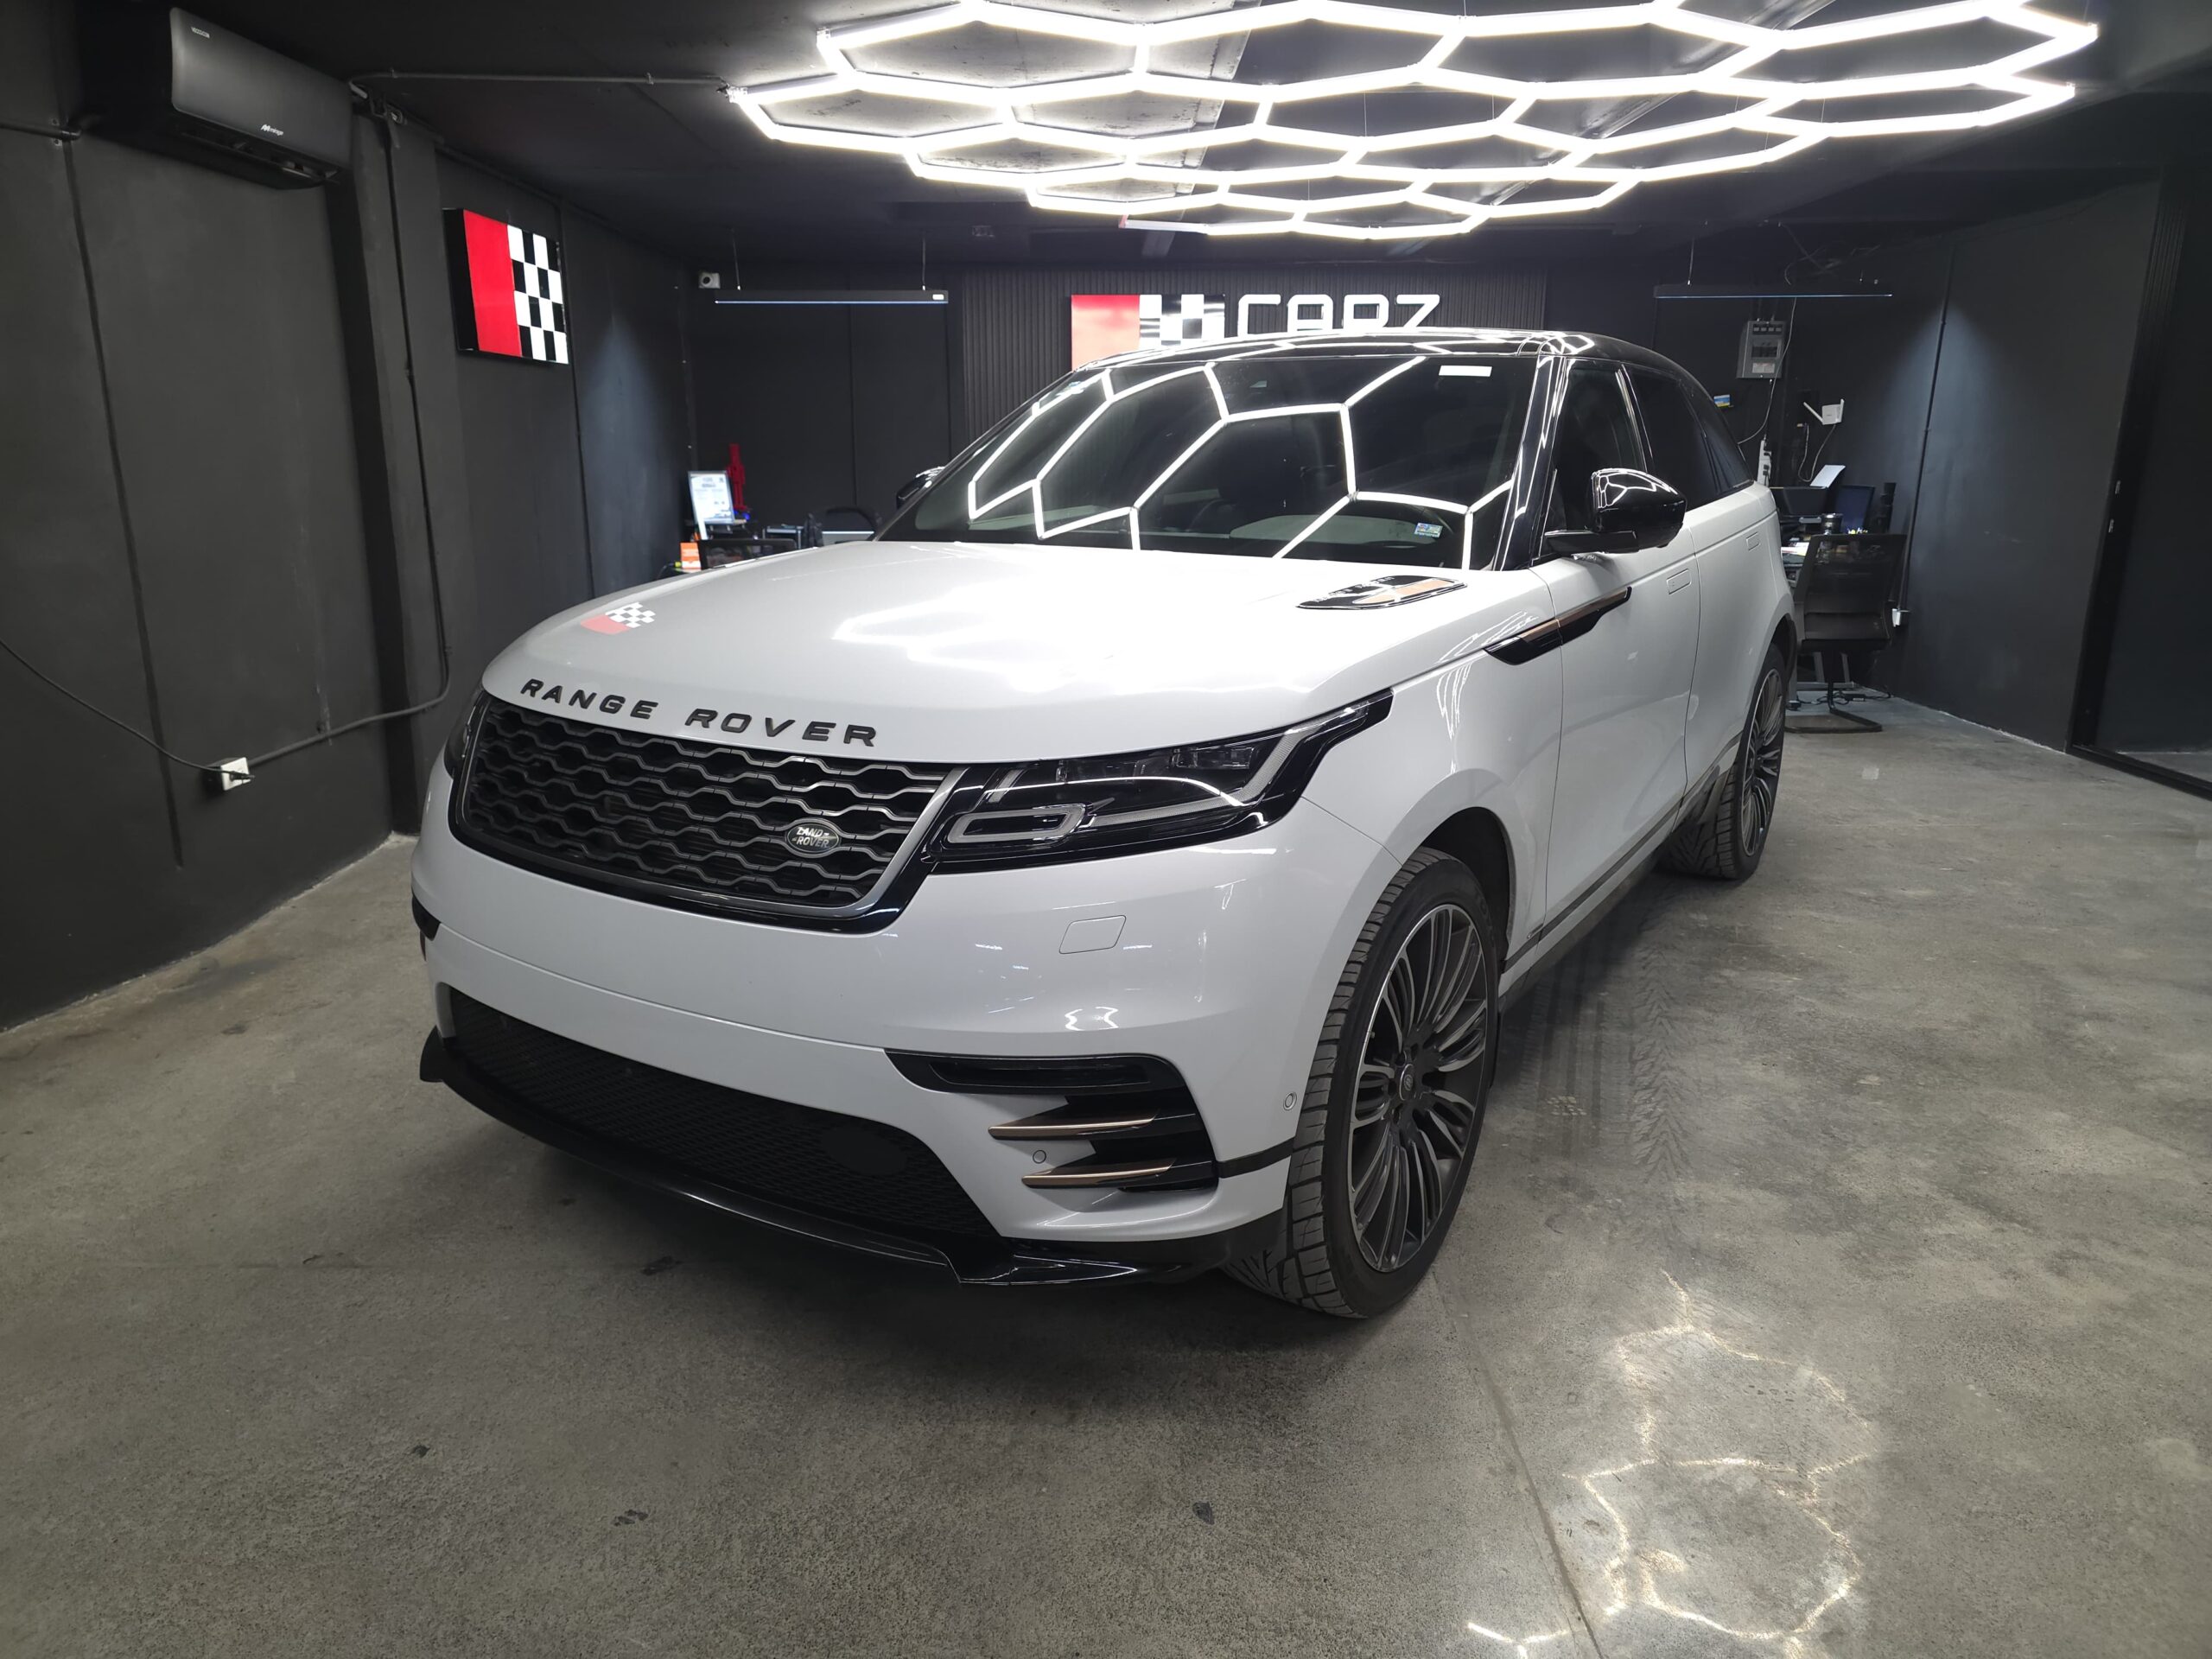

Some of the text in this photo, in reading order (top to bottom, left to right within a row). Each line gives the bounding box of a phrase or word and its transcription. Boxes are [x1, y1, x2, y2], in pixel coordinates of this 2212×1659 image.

[520, 678, 876, 747] RANGE ROVER
[796, 827, 823, 837] LAND
[796, 836, 830, 848] ROVER
